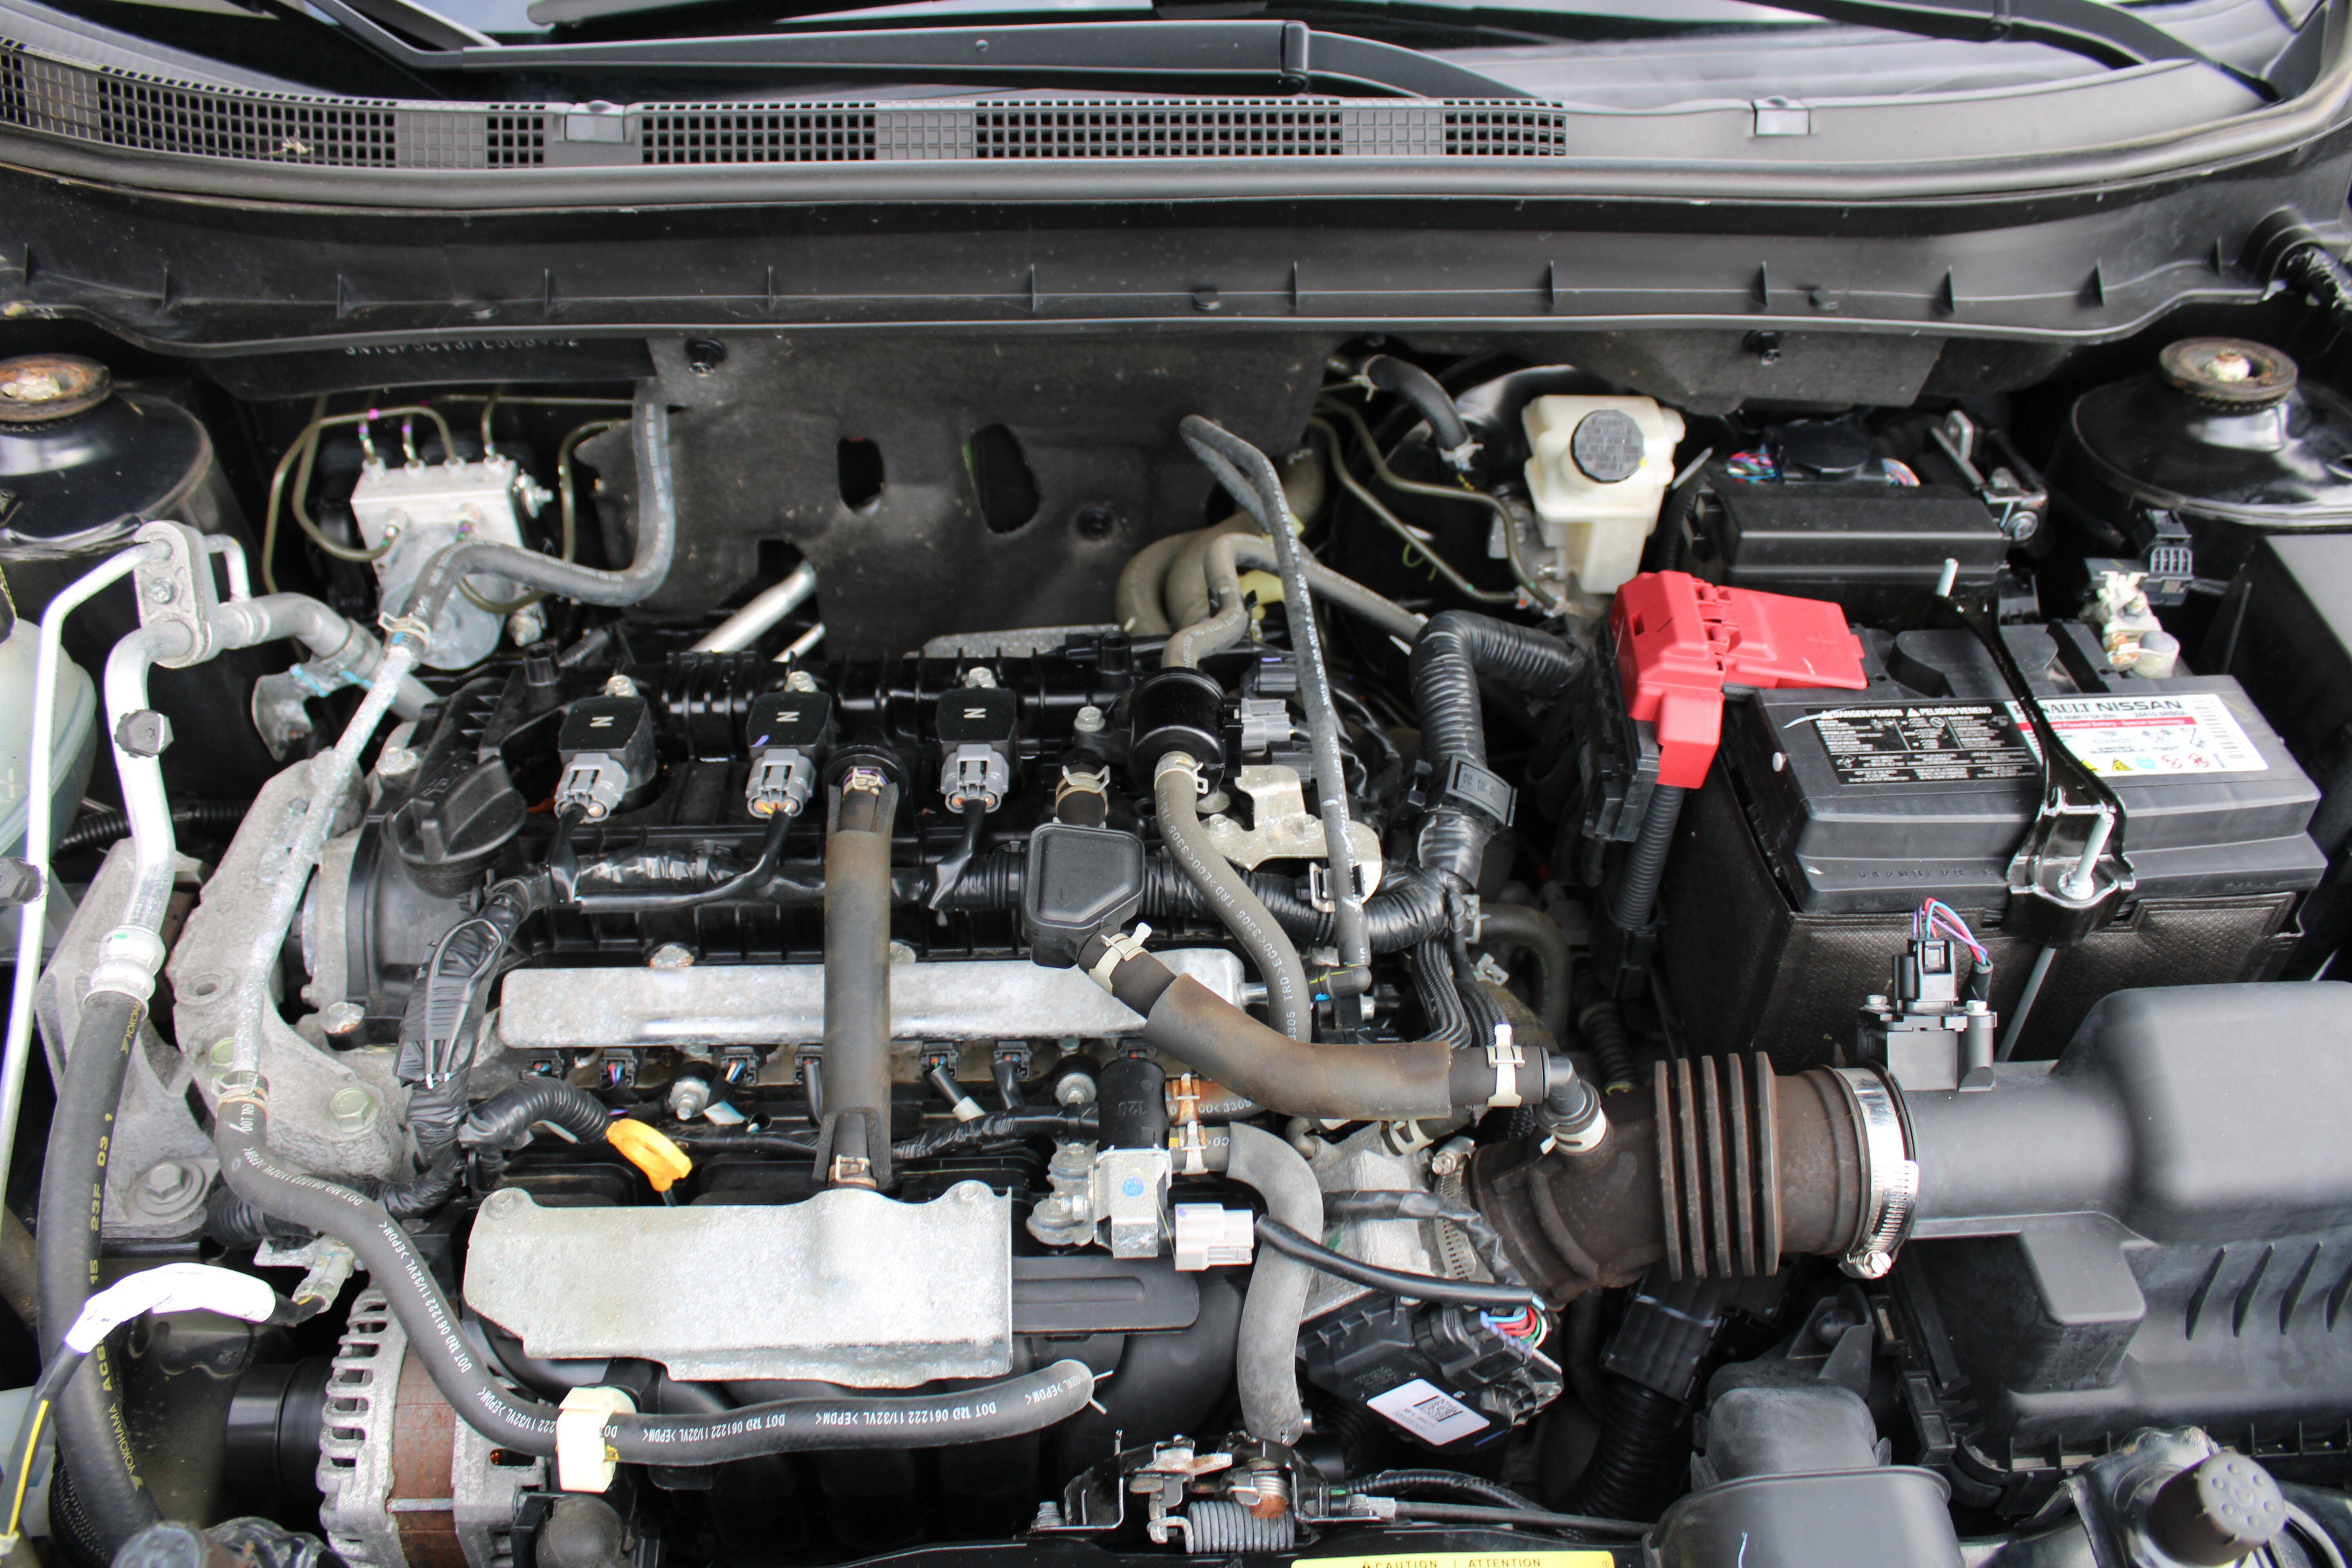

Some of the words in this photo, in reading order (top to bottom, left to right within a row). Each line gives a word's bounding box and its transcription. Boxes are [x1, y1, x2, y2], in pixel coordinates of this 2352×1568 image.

[1832, 709, 1904, 718] DANGER/POISON
[1919, 706, 1992, 716] PELIGRO/VENENO
[2012, 703, 2089, 715] RNAULT
[2096, 700, 2183, 712] NISSAN
[96, 1136, 109, 1167] 03
[89, 1183, 101, 1231] 23F
[341, 1192, 363, 1207] DOT
[89, 1258, 99, 1285] 15
[425, 1297, 452, 1336] 061222
[454, 1352, 473, 1374] DOT
[908, 1408, 949, 1425] 061222
[976, 1401, 996, 1416] DOT
[711, 1420, 743, 1439] 061222
[765, 1413, 786, 1429] DOT
[111, 1402, 137, 1475] YOKOHAMA
[1375, 1560, 1437, 1568] CAUTION
[1469, 1558, 1541, 1568] ATTENTION
